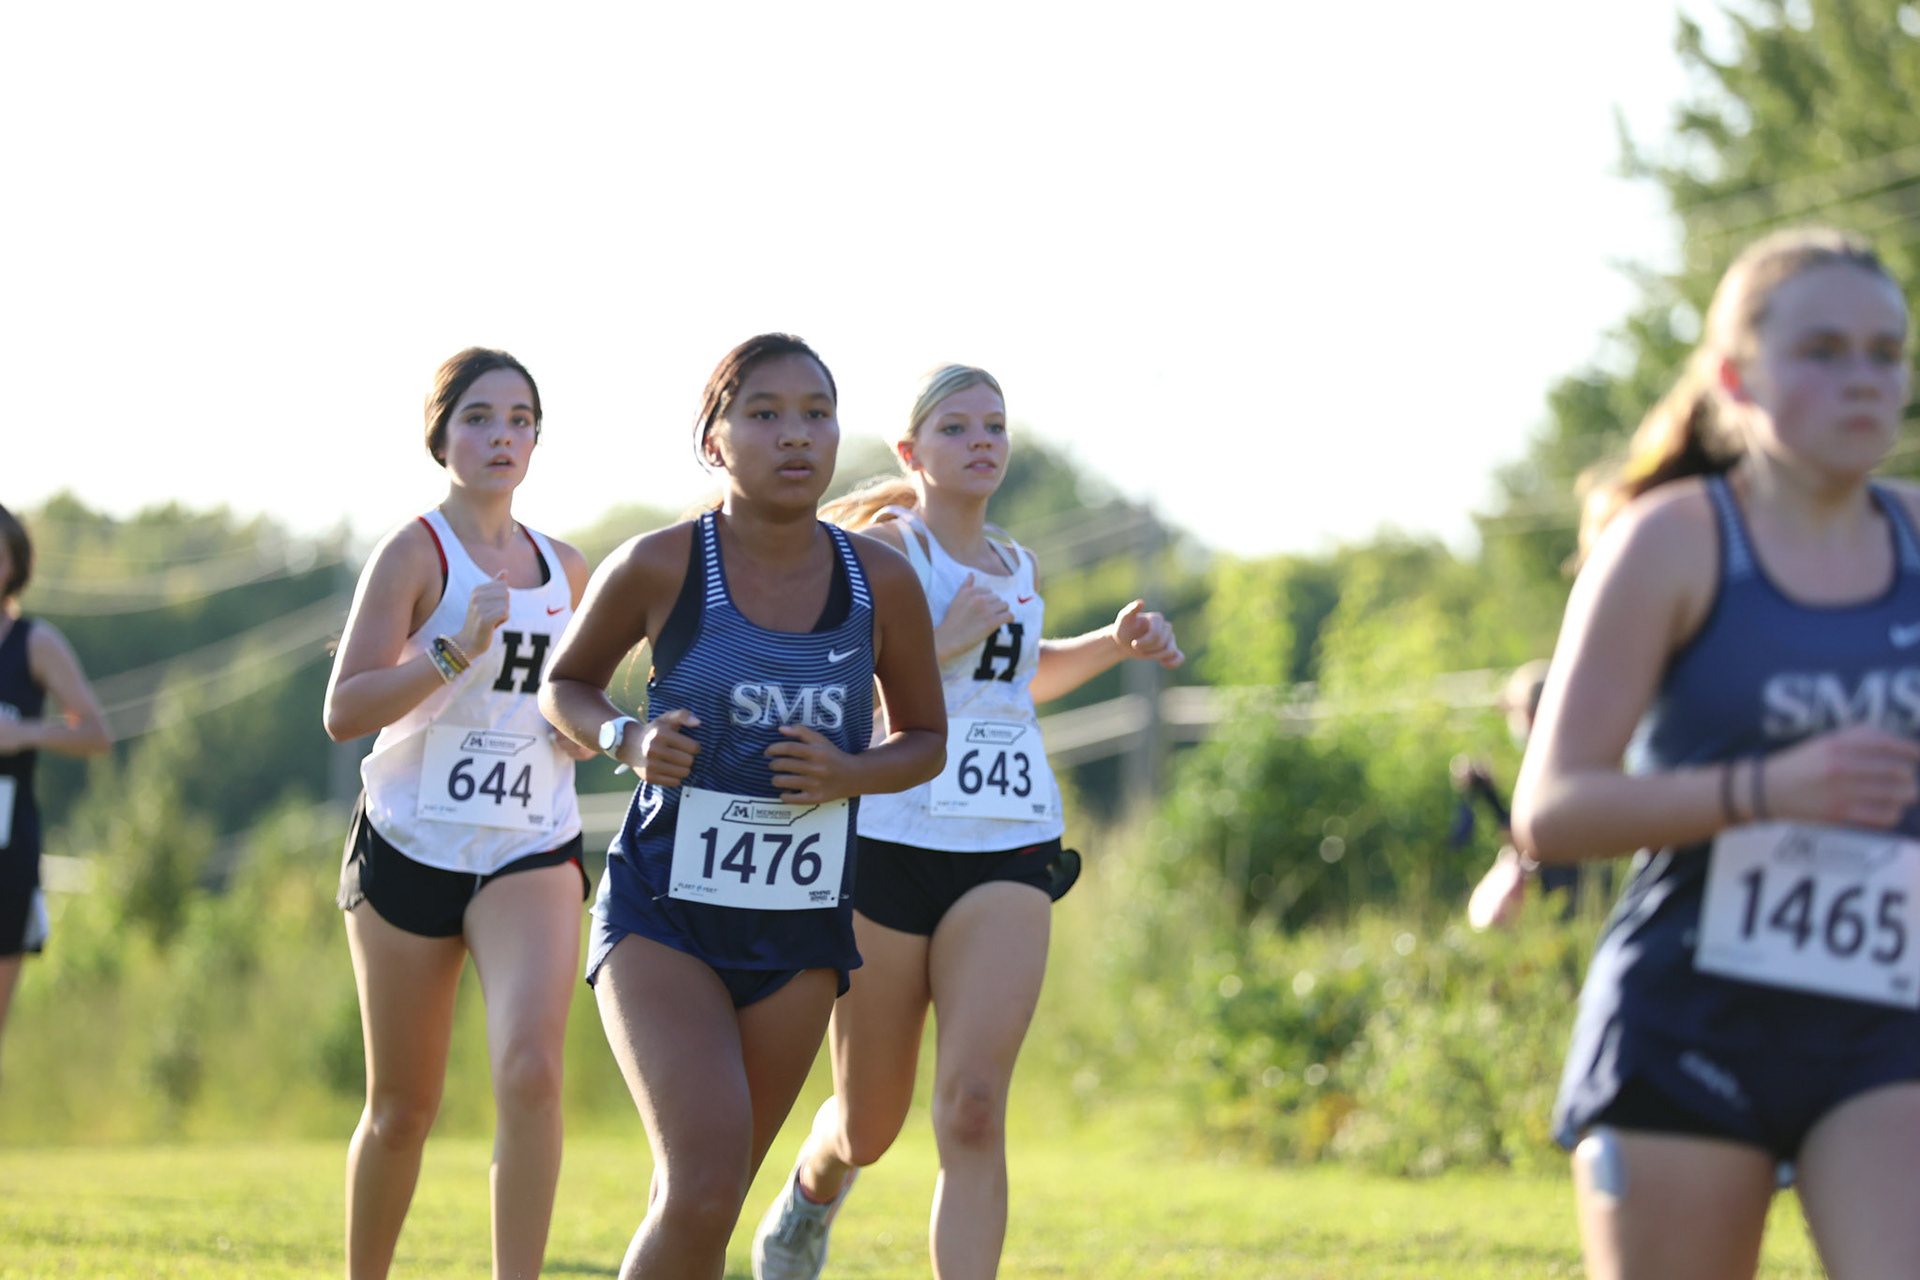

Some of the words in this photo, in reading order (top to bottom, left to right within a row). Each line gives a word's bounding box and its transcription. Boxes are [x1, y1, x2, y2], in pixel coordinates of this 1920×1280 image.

[493, 630, 550, 694] H
[973, 622, 1024, 683] H
[730, 681, 847, 729] SMS
[1763, 669, 1920, 745] SMS
[447, 757, 532, 808] 644
[958, 749, 1031, 798] 643
[700, 826, 822, 886] 1476
[1738, 866, 1909, 966] 1465
